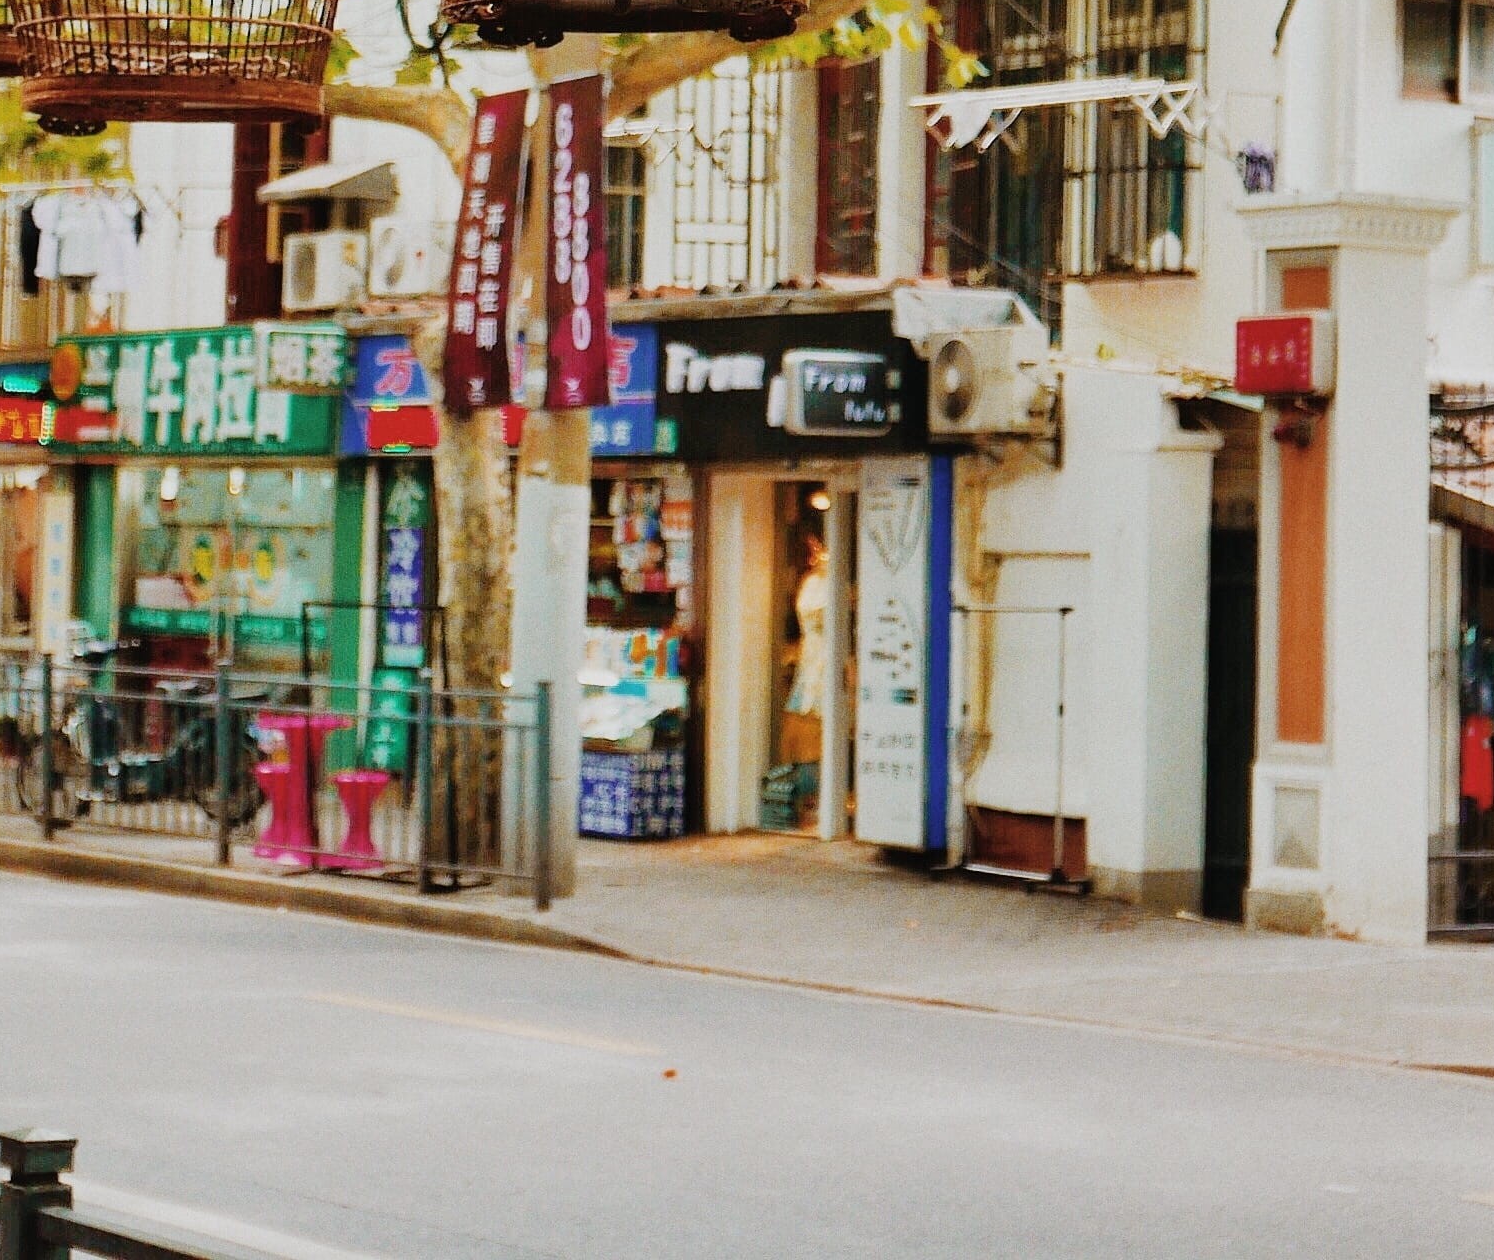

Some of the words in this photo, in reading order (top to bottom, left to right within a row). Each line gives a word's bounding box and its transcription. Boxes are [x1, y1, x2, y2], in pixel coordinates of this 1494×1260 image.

[554, 103, 574, 284] 6288
[571, 172, 592, 351] 8800
[665, 342, 765, 393] From
[805, 364, 867, 393] From
